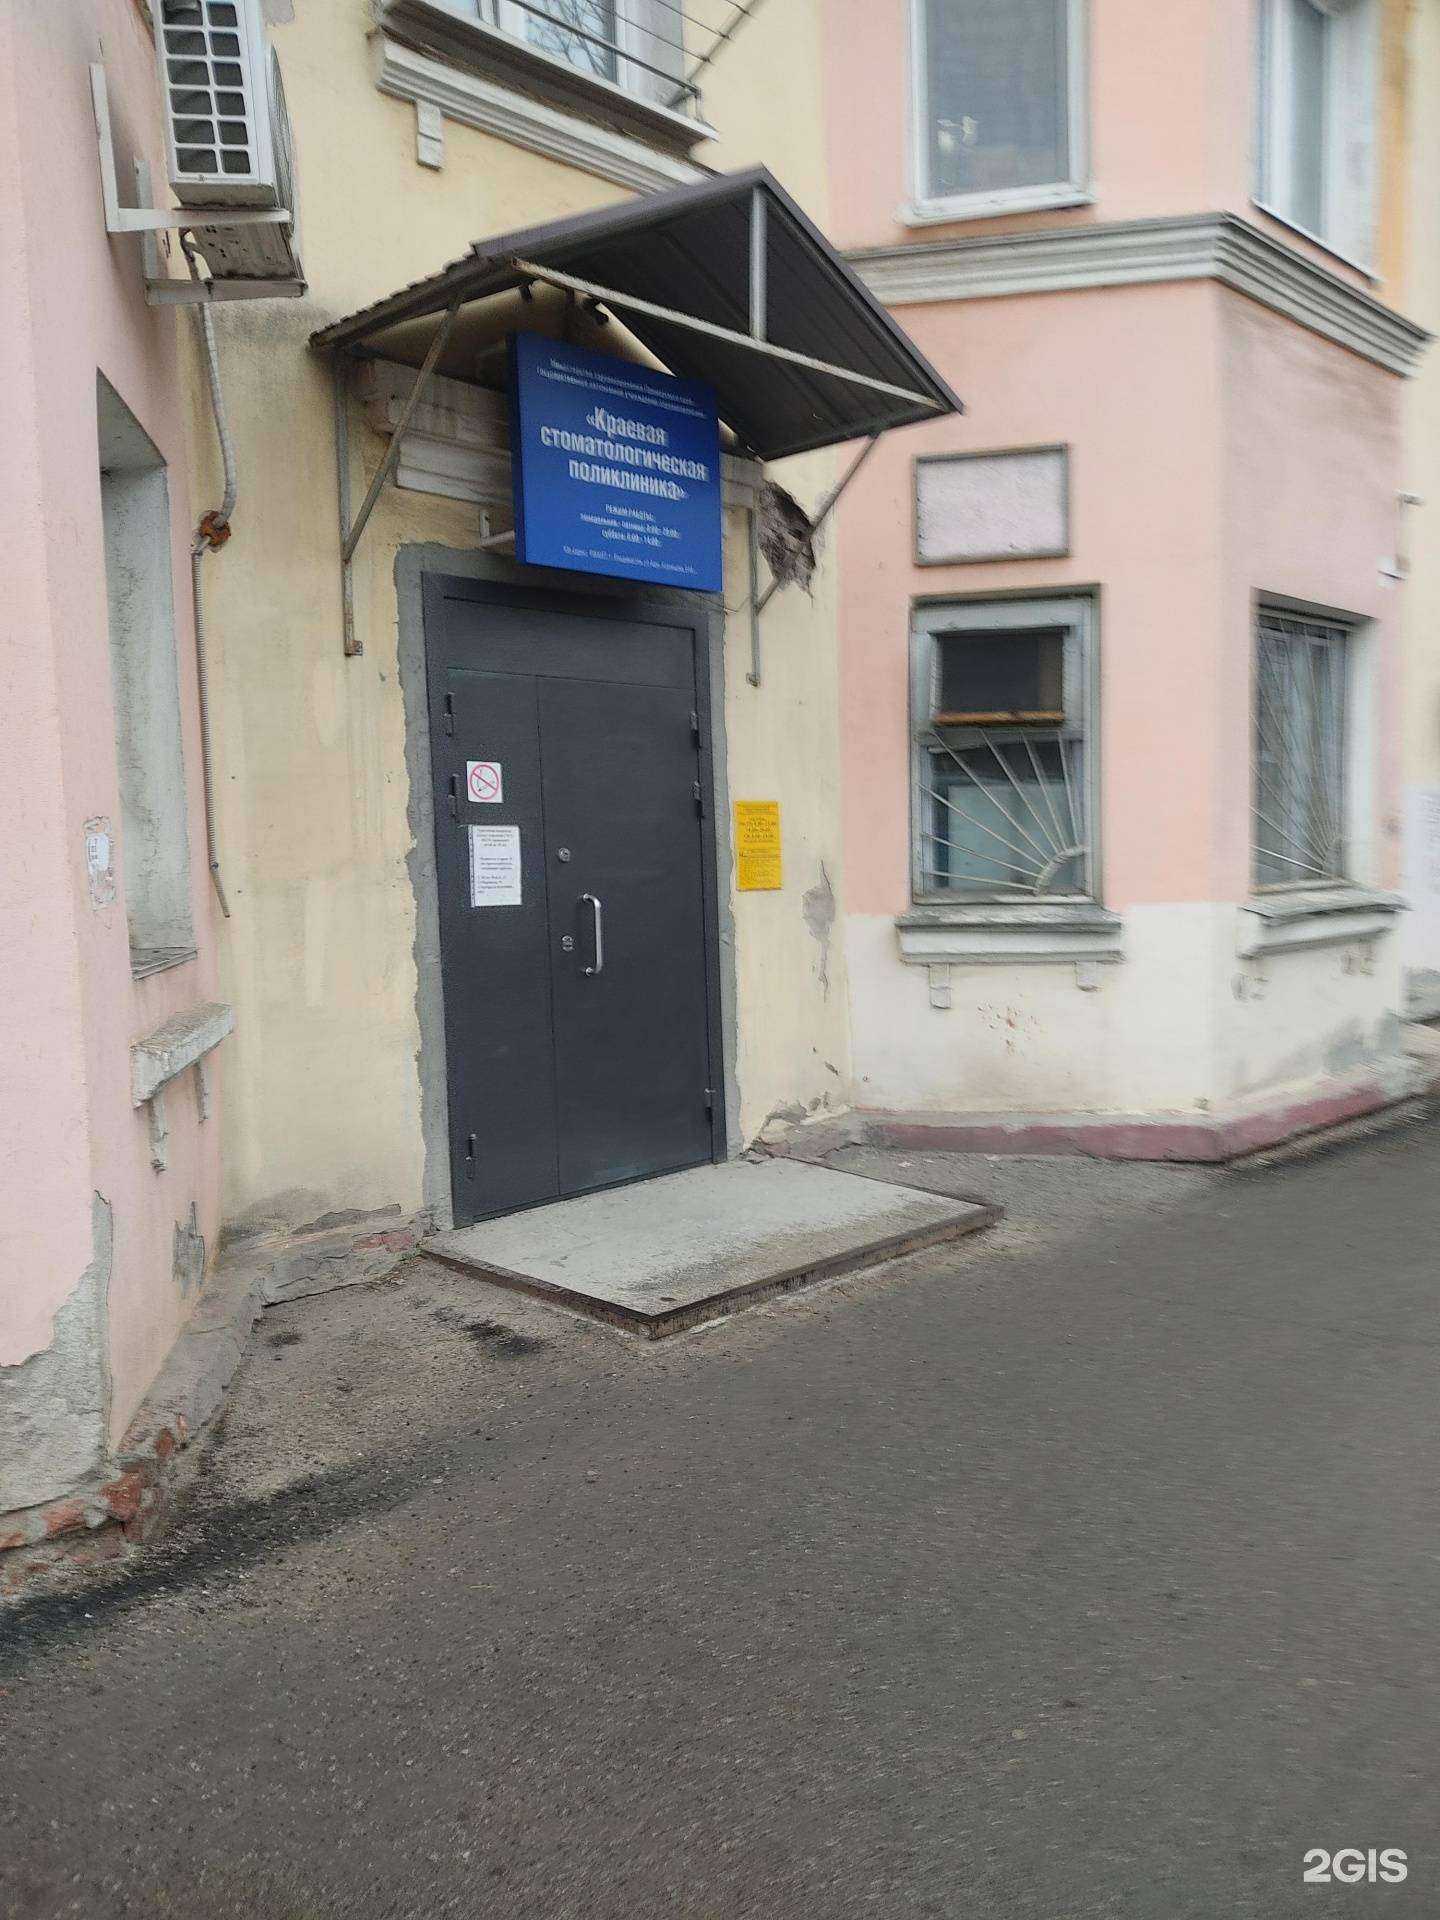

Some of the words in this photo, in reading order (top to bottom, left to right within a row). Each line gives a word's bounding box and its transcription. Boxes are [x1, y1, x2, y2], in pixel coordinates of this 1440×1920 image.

[586, 406, 667, 447] «Краевая
[541, 426, 708, 482] стоматологическая
[569, 460, 688, 501] поликлиника»
